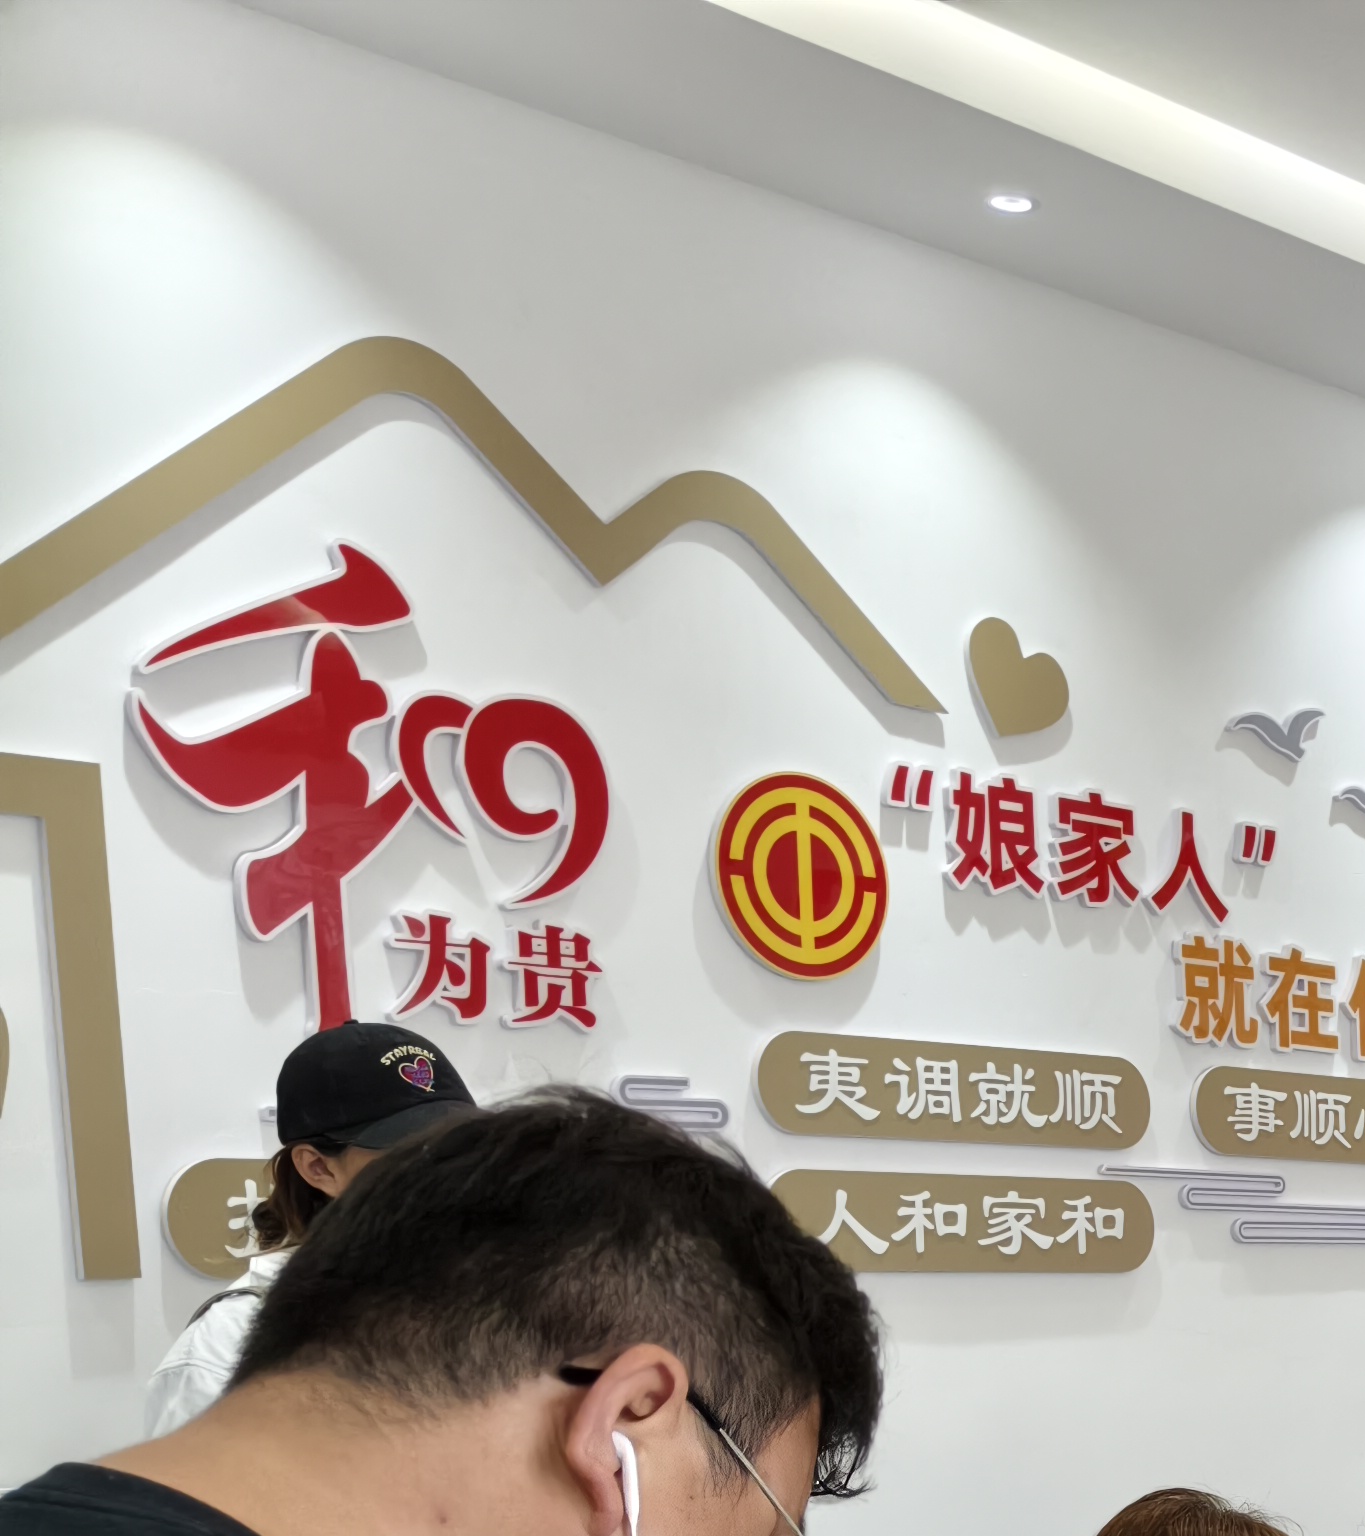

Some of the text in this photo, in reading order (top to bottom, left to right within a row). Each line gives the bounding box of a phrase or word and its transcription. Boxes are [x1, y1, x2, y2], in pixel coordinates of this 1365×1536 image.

[396, 914, 603, 1028] 为贵
[380, 1045, 437, 1066] STAYREAL
[795, 1049, 1123, 1134] 夷调就顺
[816, 1189, 1125, 1255] 人和家和
